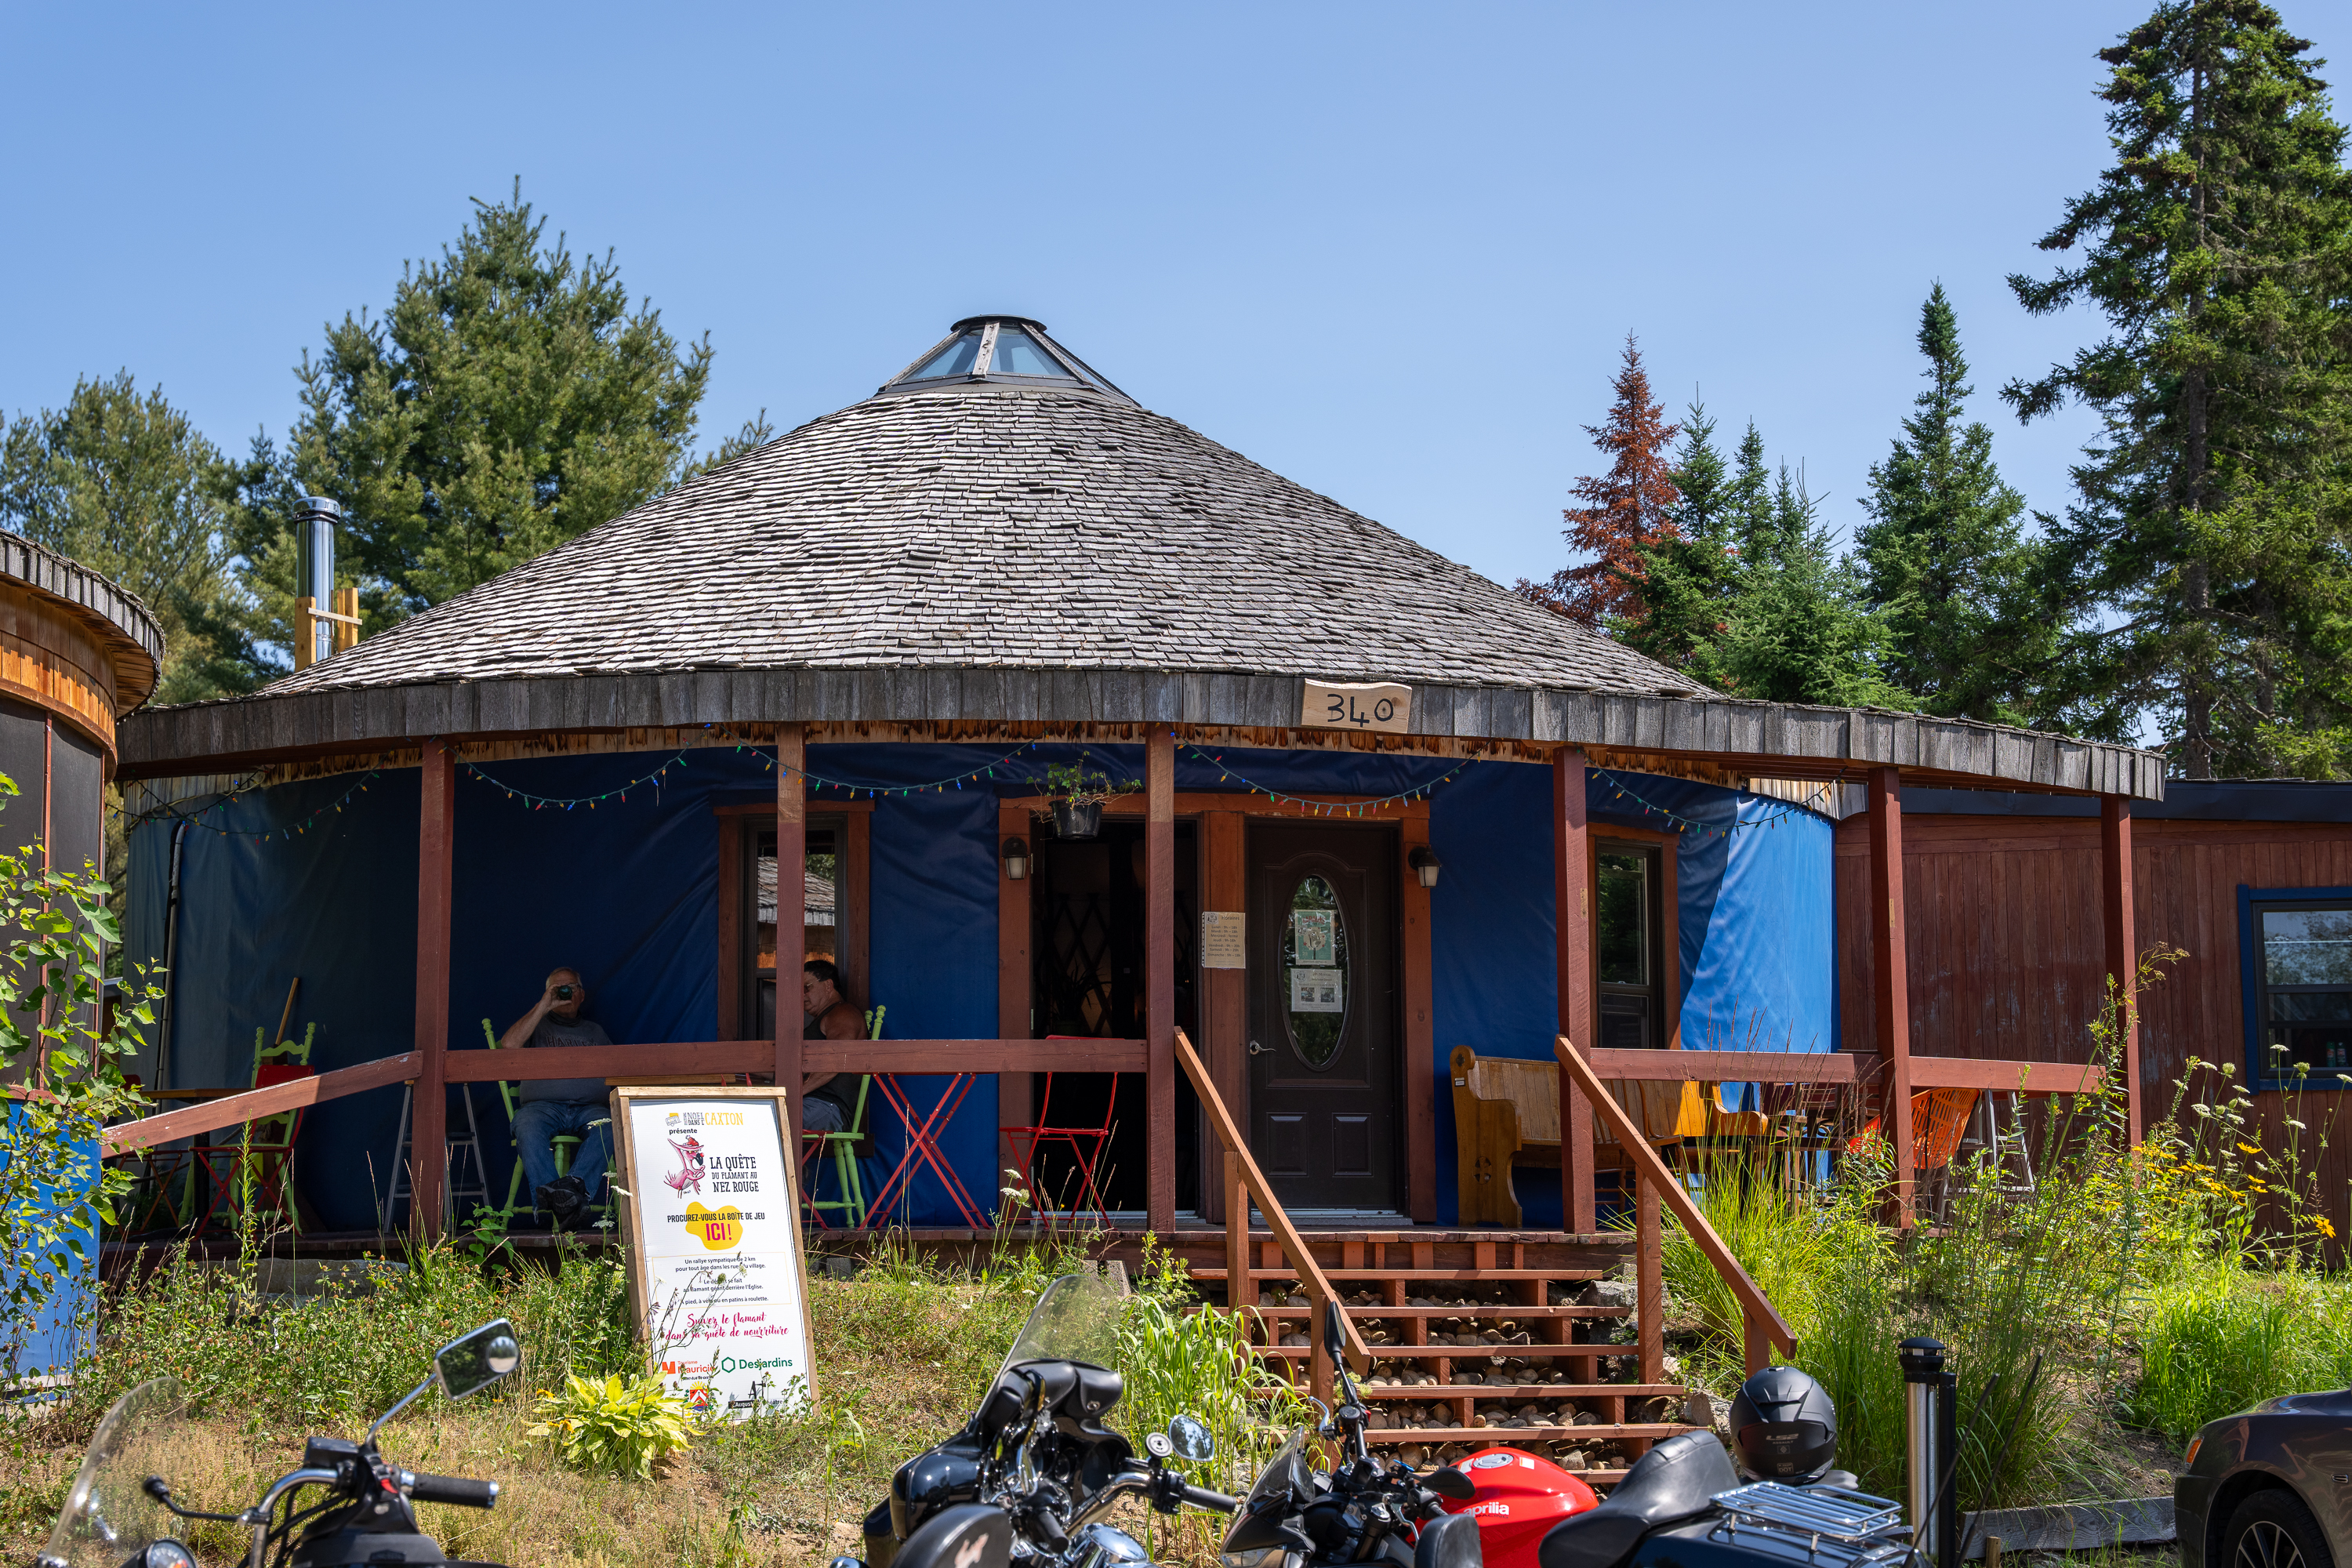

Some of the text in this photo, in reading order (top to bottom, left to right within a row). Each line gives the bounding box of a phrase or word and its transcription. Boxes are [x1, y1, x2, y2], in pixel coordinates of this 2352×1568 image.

[1327, 693, 1393, 728] 340
[705, 1112, 744, 1125] CAXTON
[710, 1153, 757, 1171] LA QUÊTE
[713, 1181, 759, 1192] NEZ ROUGE
[667, 1213, 717, 1223] PROCUREZ-VOUS
[706, 1223, 726, 1241] ICI
[687, 1311, 766, 1329] Suivez le flamant
[704, 1326, 726, 1341] quête
[730, 1327, 741, 1337] de
[744, 1324, 789, 1339] nourriture
[739, 1357, 793, 1371] Desjardins
[1463, 1501, 1510, 1518] aprilia
